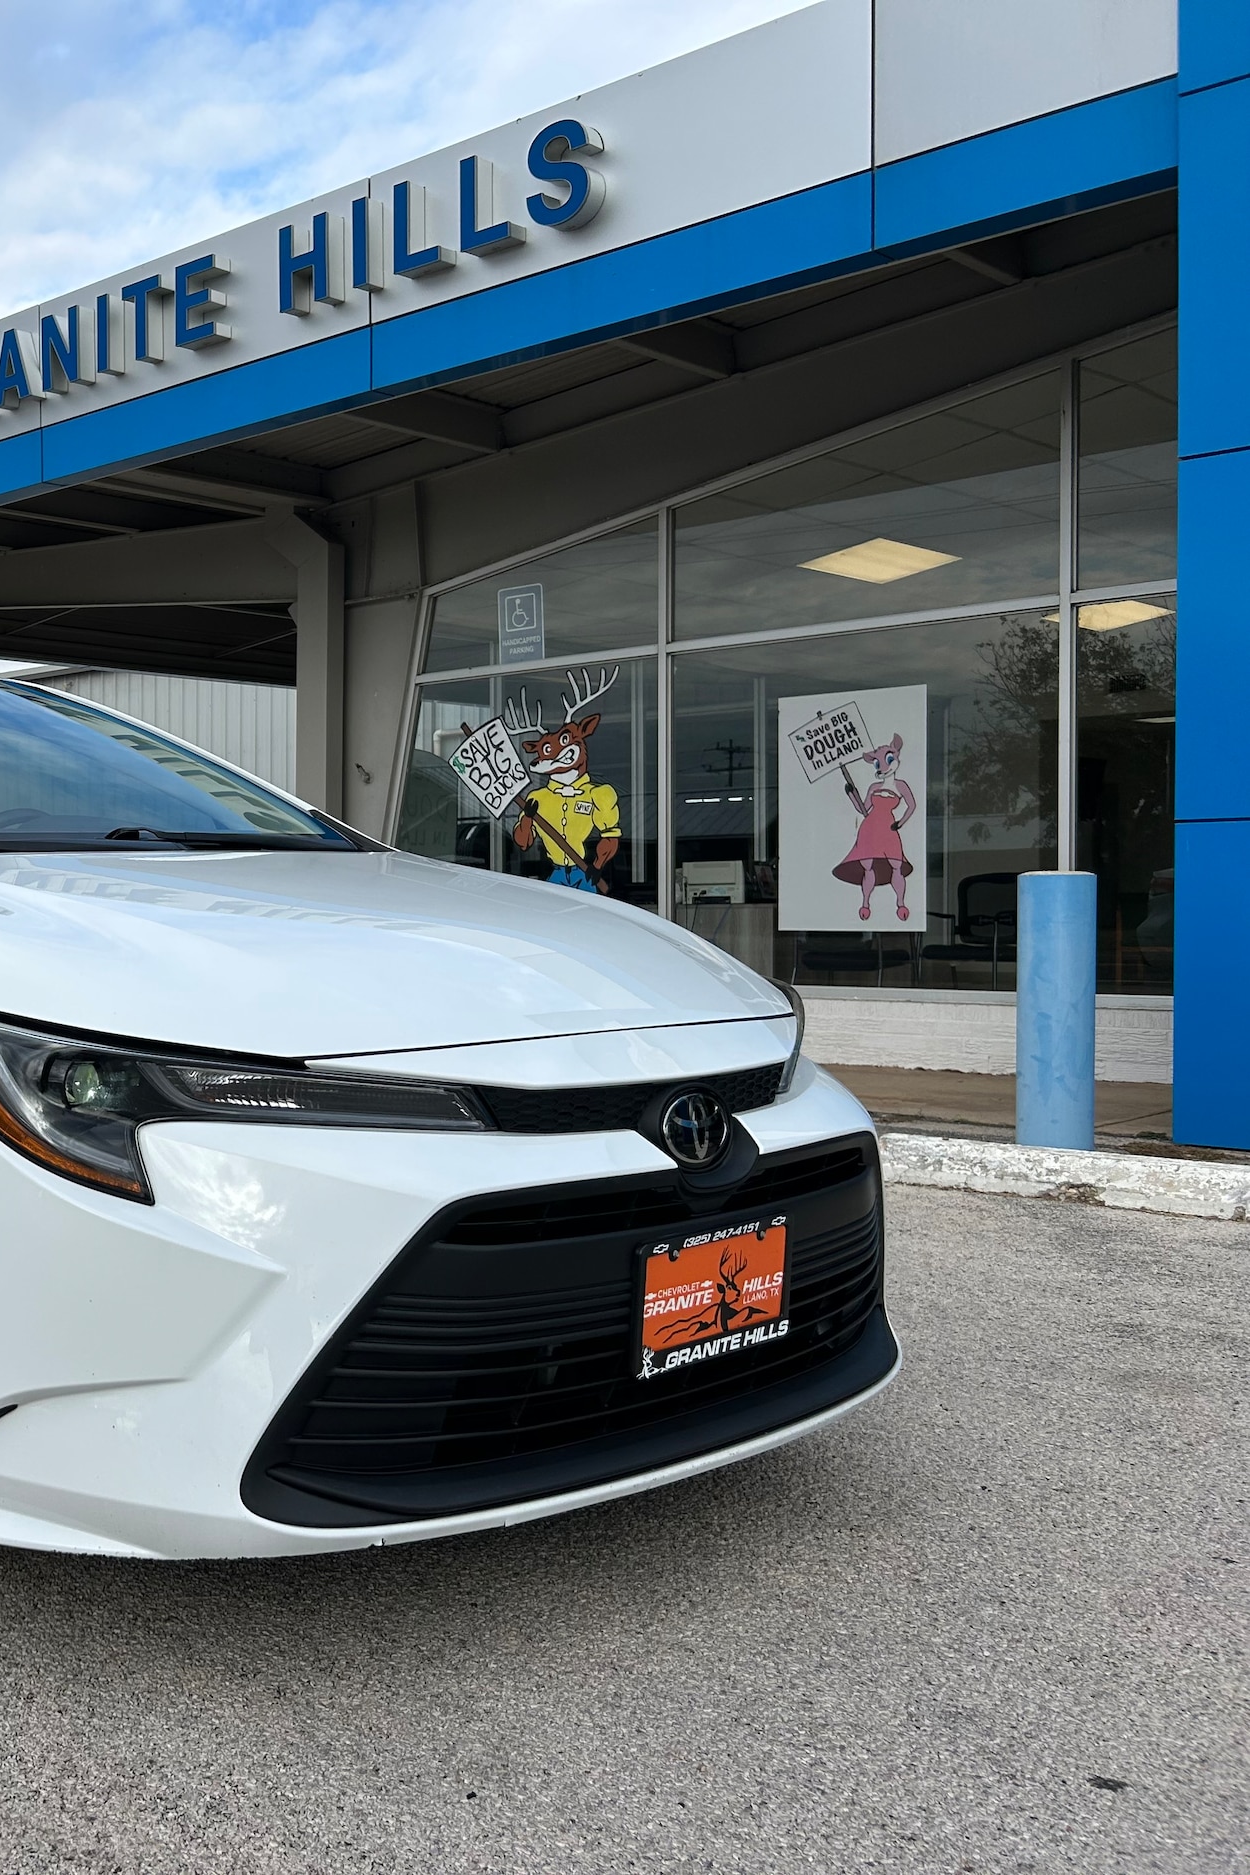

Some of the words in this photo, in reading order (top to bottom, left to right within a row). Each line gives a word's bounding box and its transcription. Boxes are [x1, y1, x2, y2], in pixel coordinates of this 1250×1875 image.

[278, 119, 605, 316] HILLS
[502, 635, 541, 647] HANDICAPPED
[509, 645, 534, 655] PARKING
[805, 723, 830, 740] Save
[830, 711, 848, 727] BIG
[803, 721, 858, 760] DOUGH
[823, 737, 863, 764] LLANO!
[469, 746, 511, 790] BIG
[485, 763, 526, 809] BUCKS
[683, 1233, 711, 1249] (325)
[713, 1221, 760, 1241] 247-4151
[657, 1281, 701, 1299] CHEVROLET
[742, 1272, 783, 1294] HILLS
[742, 1290, 768, 1305] LLANO,
[770, 1287, 779, 1297] TX
[643, 1289, 714, 1318] GRANITE
[665, 1332, 742, 1369] GRANITE
[743, 1319, 789, 1347] HILLS
